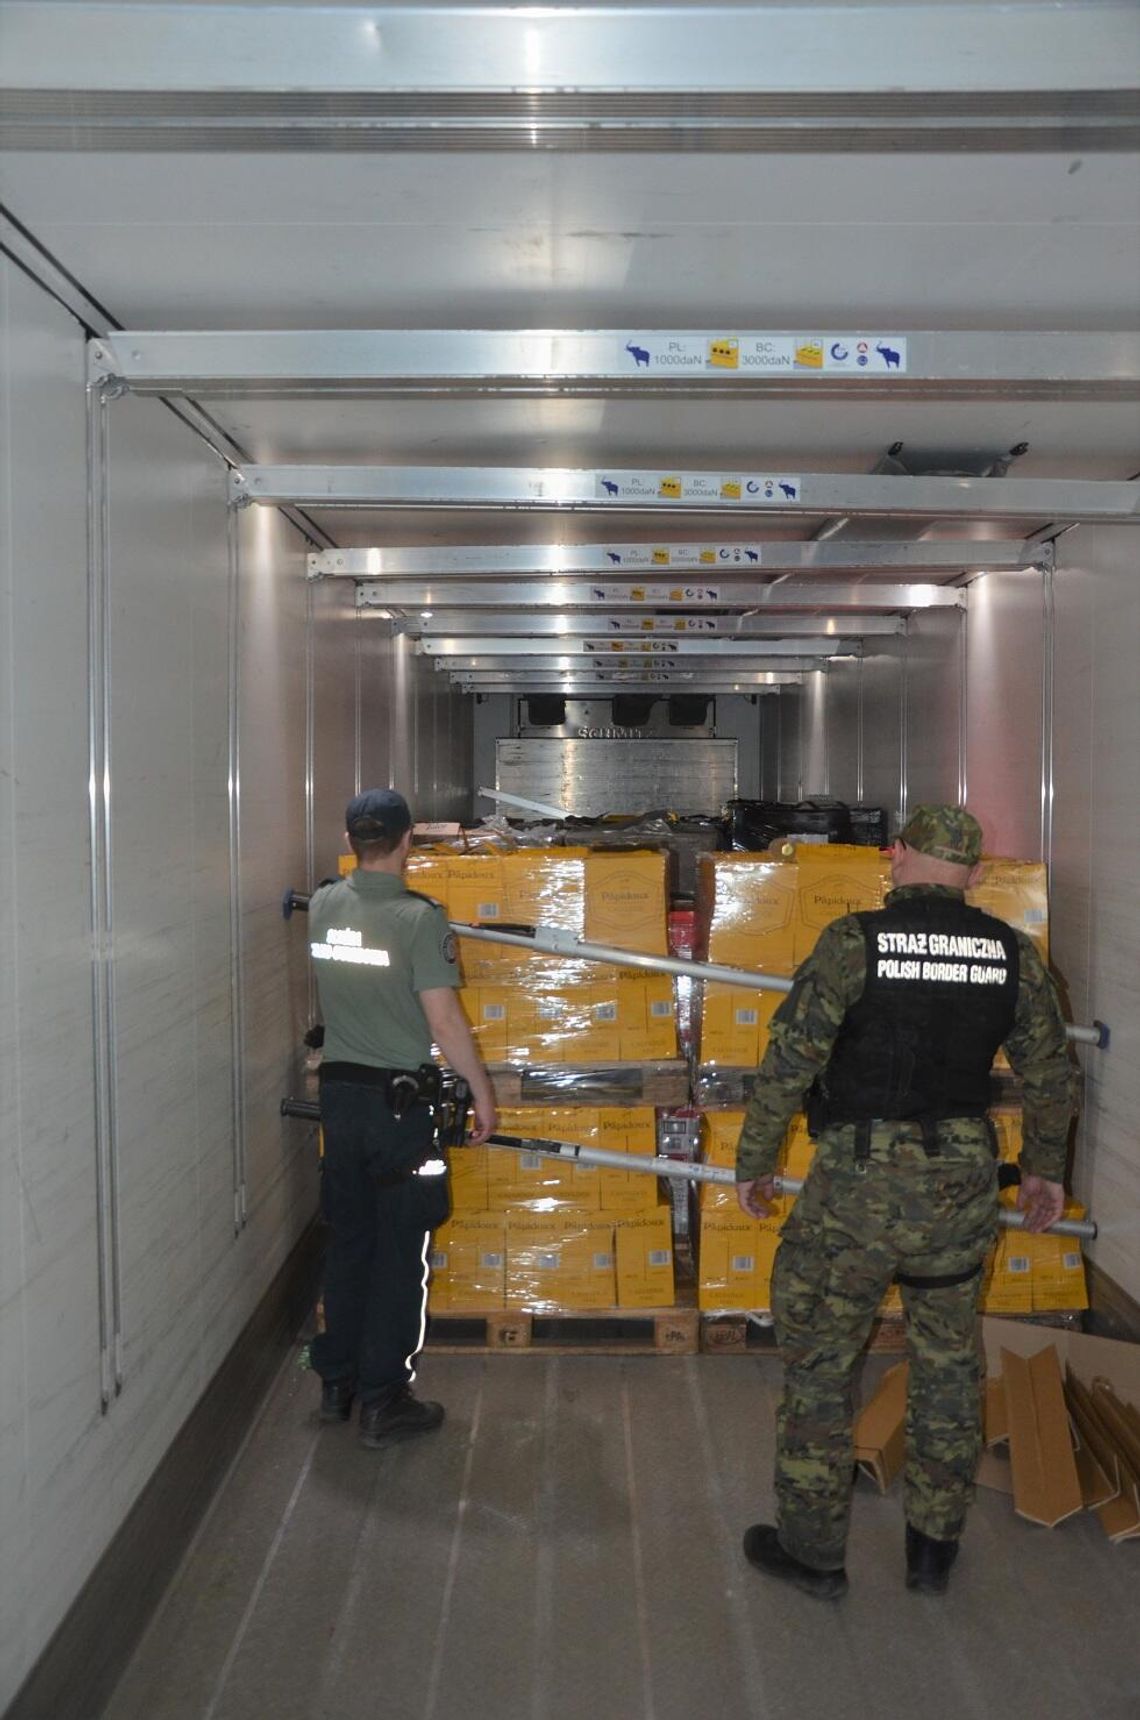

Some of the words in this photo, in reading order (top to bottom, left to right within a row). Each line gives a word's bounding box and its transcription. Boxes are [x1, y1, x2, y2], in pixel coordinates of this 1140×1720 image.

[654, 355, 702, 365] 1000daN
[742, 355, 790, 366] 3000daN
[928, 933, 1007, 960] GRANICZNA
[877, 959, 921, 980] POLISH
[922, 961, 968, 983] BORDER
[969, 964, 1008, 985] GUARD
